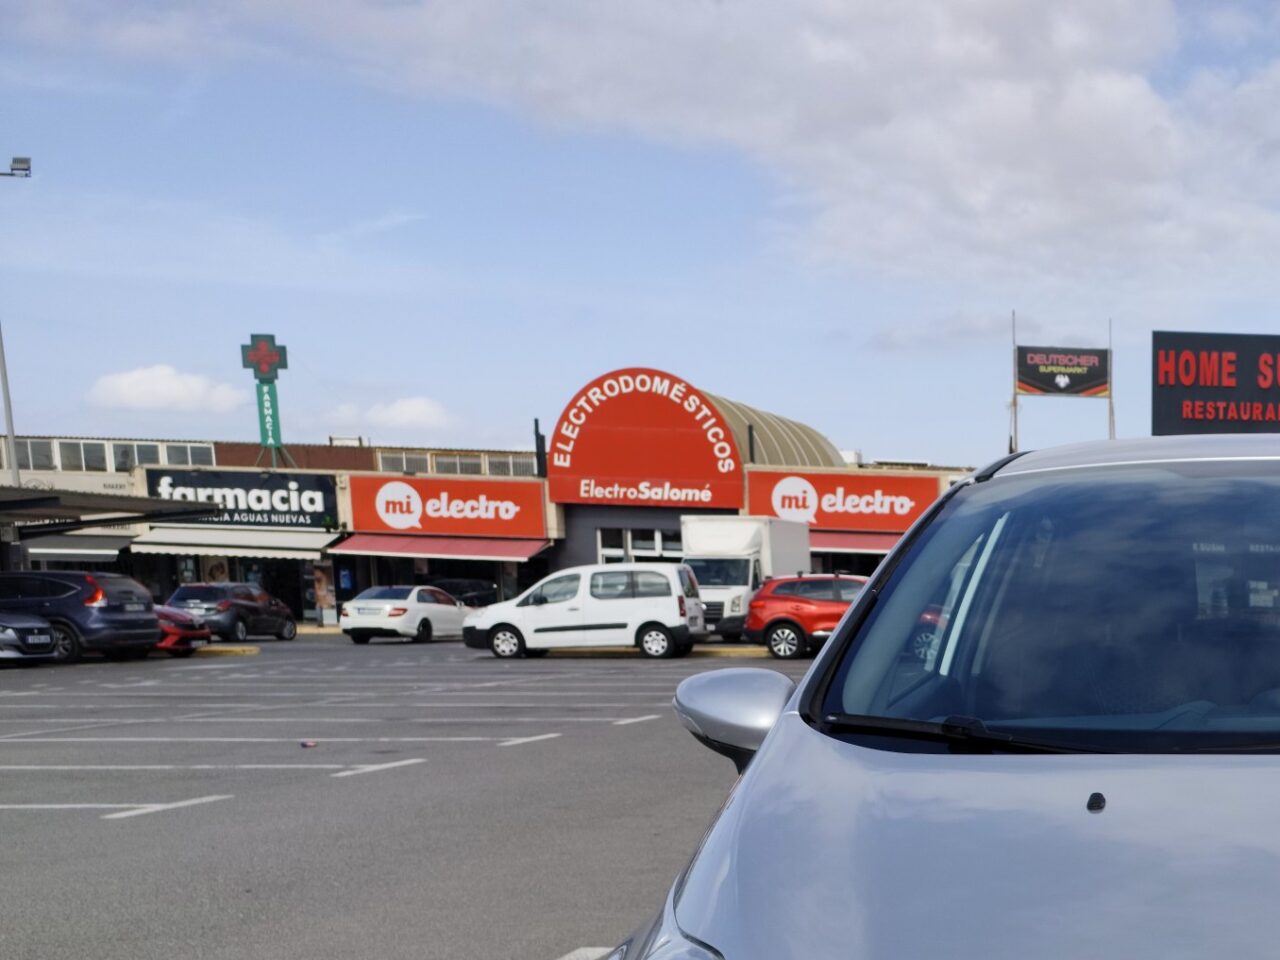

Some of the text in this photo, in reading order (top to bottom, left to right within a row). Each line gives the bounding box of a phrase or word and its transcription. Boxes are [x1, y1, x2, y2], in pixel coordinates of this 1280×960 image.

[1027, 353, 1099, 366] DEUTSCHER
[1158, 350, 1237, 387] HOME
[263, 385, 275, 445] FARMACIA
[553, 374, 735, 473] ELECTRODOMÉSTICOS
[157, 476, 325, 513] farmacia
[580, 479, 713, 502] ElectroSalomé
[781, 487, 916, 515] mi electro
[233, 513, 268, 523] AGUAS
[271, 514, 311, 524] NUEVAS
[384, 492, 520, 520] mi electro
